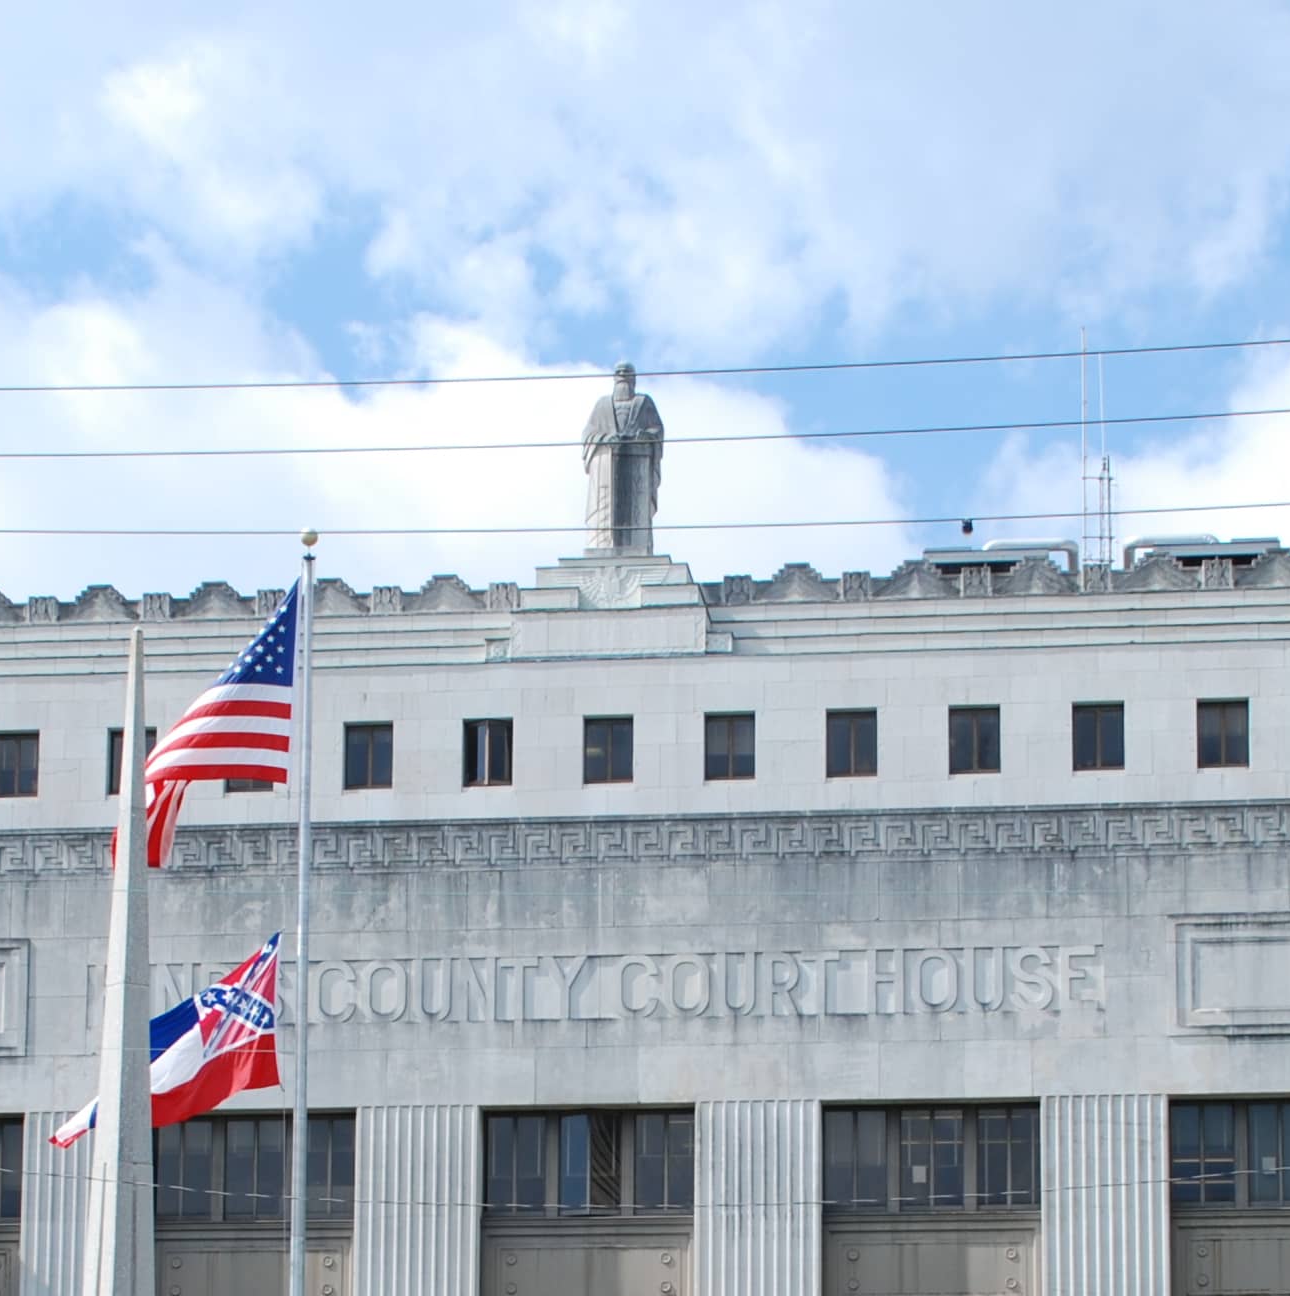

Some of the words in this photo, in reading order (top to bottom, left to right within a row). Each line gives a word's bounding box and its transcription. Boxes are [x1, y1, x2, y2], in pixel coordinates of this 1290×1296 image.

[311, 956, 589, 1023] COUNTY
[612, 951, 840, 1018] COURT
[867, 946, 1097, 1014] HOUSE
